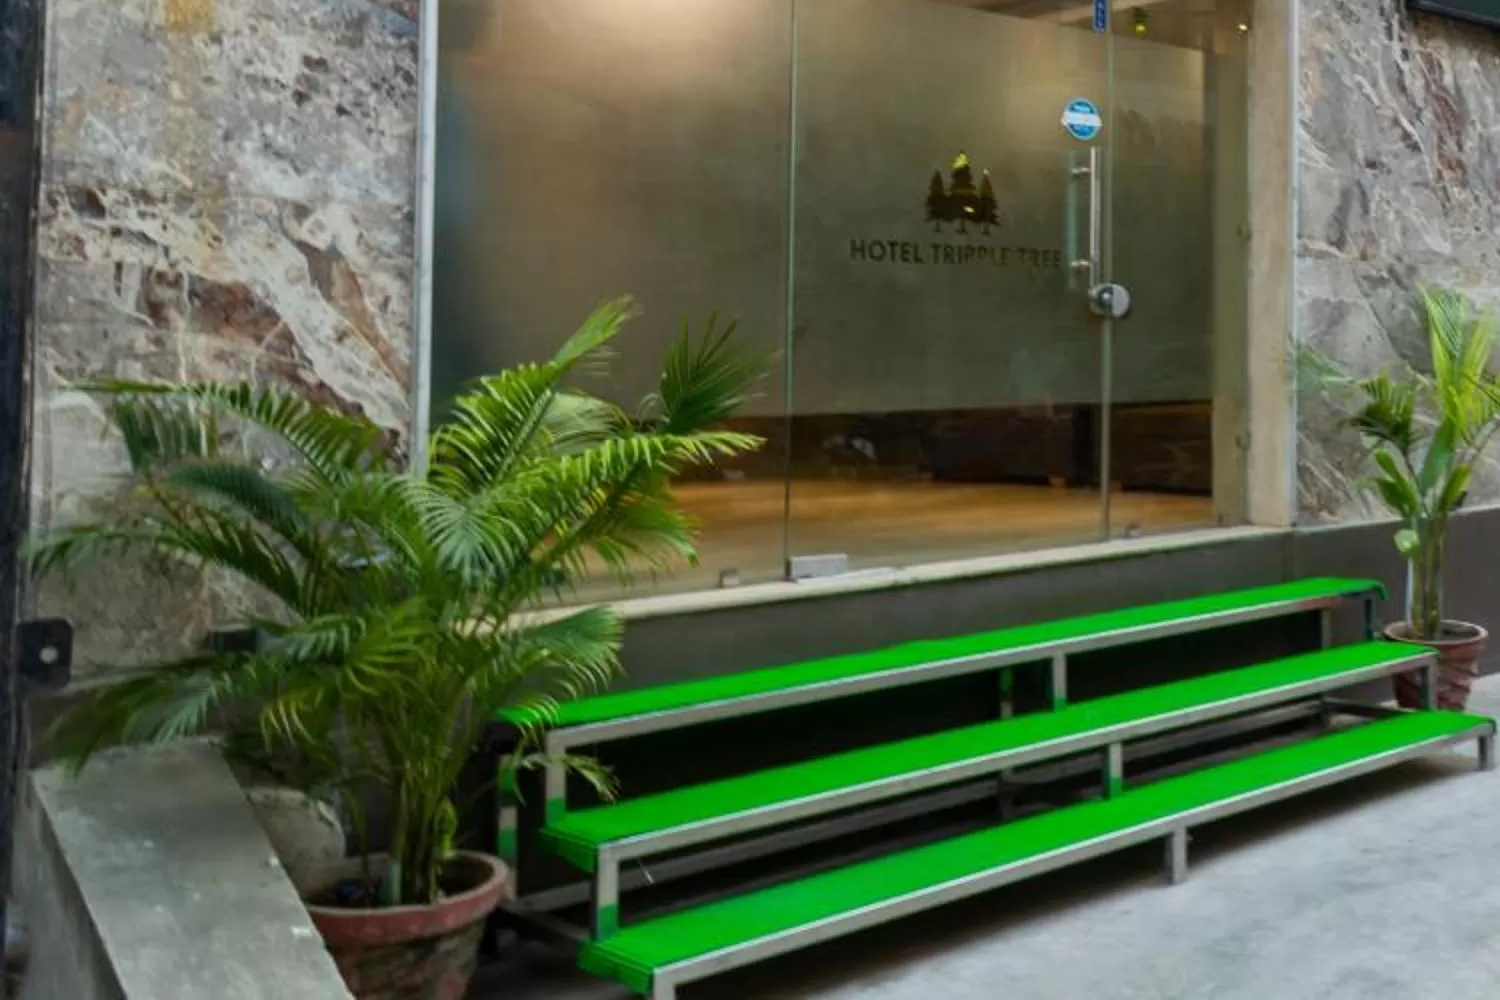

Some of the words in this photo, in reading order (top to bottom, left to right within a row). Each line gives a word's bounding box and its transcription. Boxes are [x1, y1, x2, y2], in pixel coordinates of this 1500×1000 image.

[851, 238, 923, 264] HOTEL
[930, 242, 1008, 266] TRIPPLE
[1015, 247, 1062, 269] TREE
